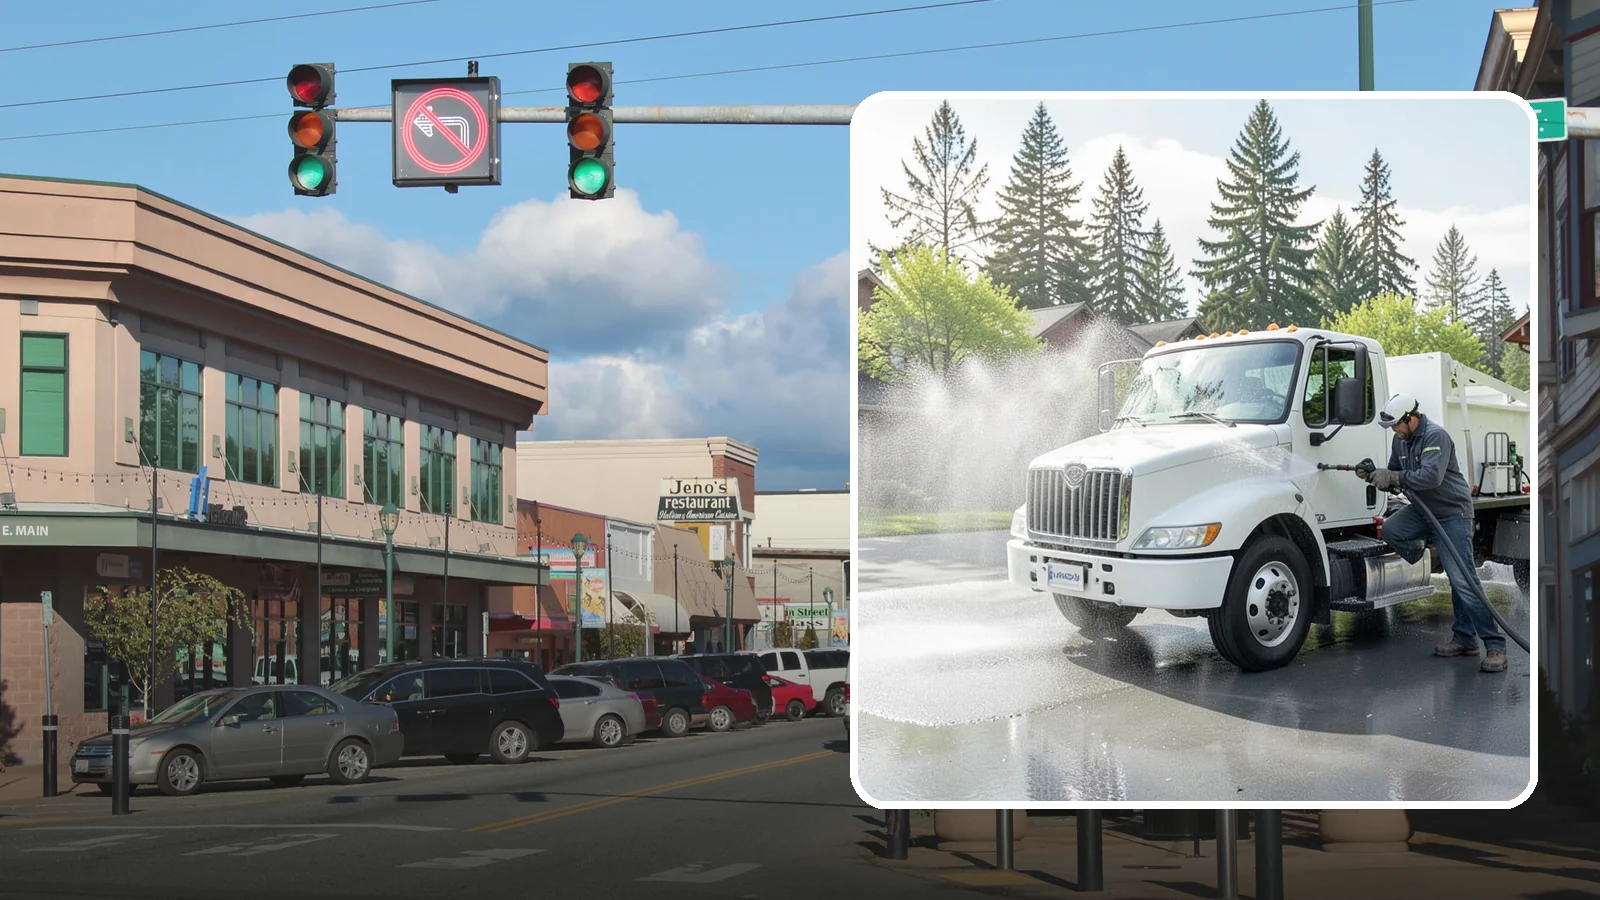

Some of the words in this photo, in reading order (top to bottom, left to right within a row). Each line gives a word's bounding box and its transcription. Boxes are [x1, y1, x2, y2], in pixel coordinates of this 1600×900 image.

[669, 480, 727, 494] Jeno's
[665, 496, 731, 509] restaurant
[659, 510, 681, 520] Italian
[686, 509, 715, 520] American
[715, 509, 738, 520] Cuisine
[2, 525, 13, 536] E.
[15, 525, 49, 536] MAIN
[797, 608, 828, 616] Street
